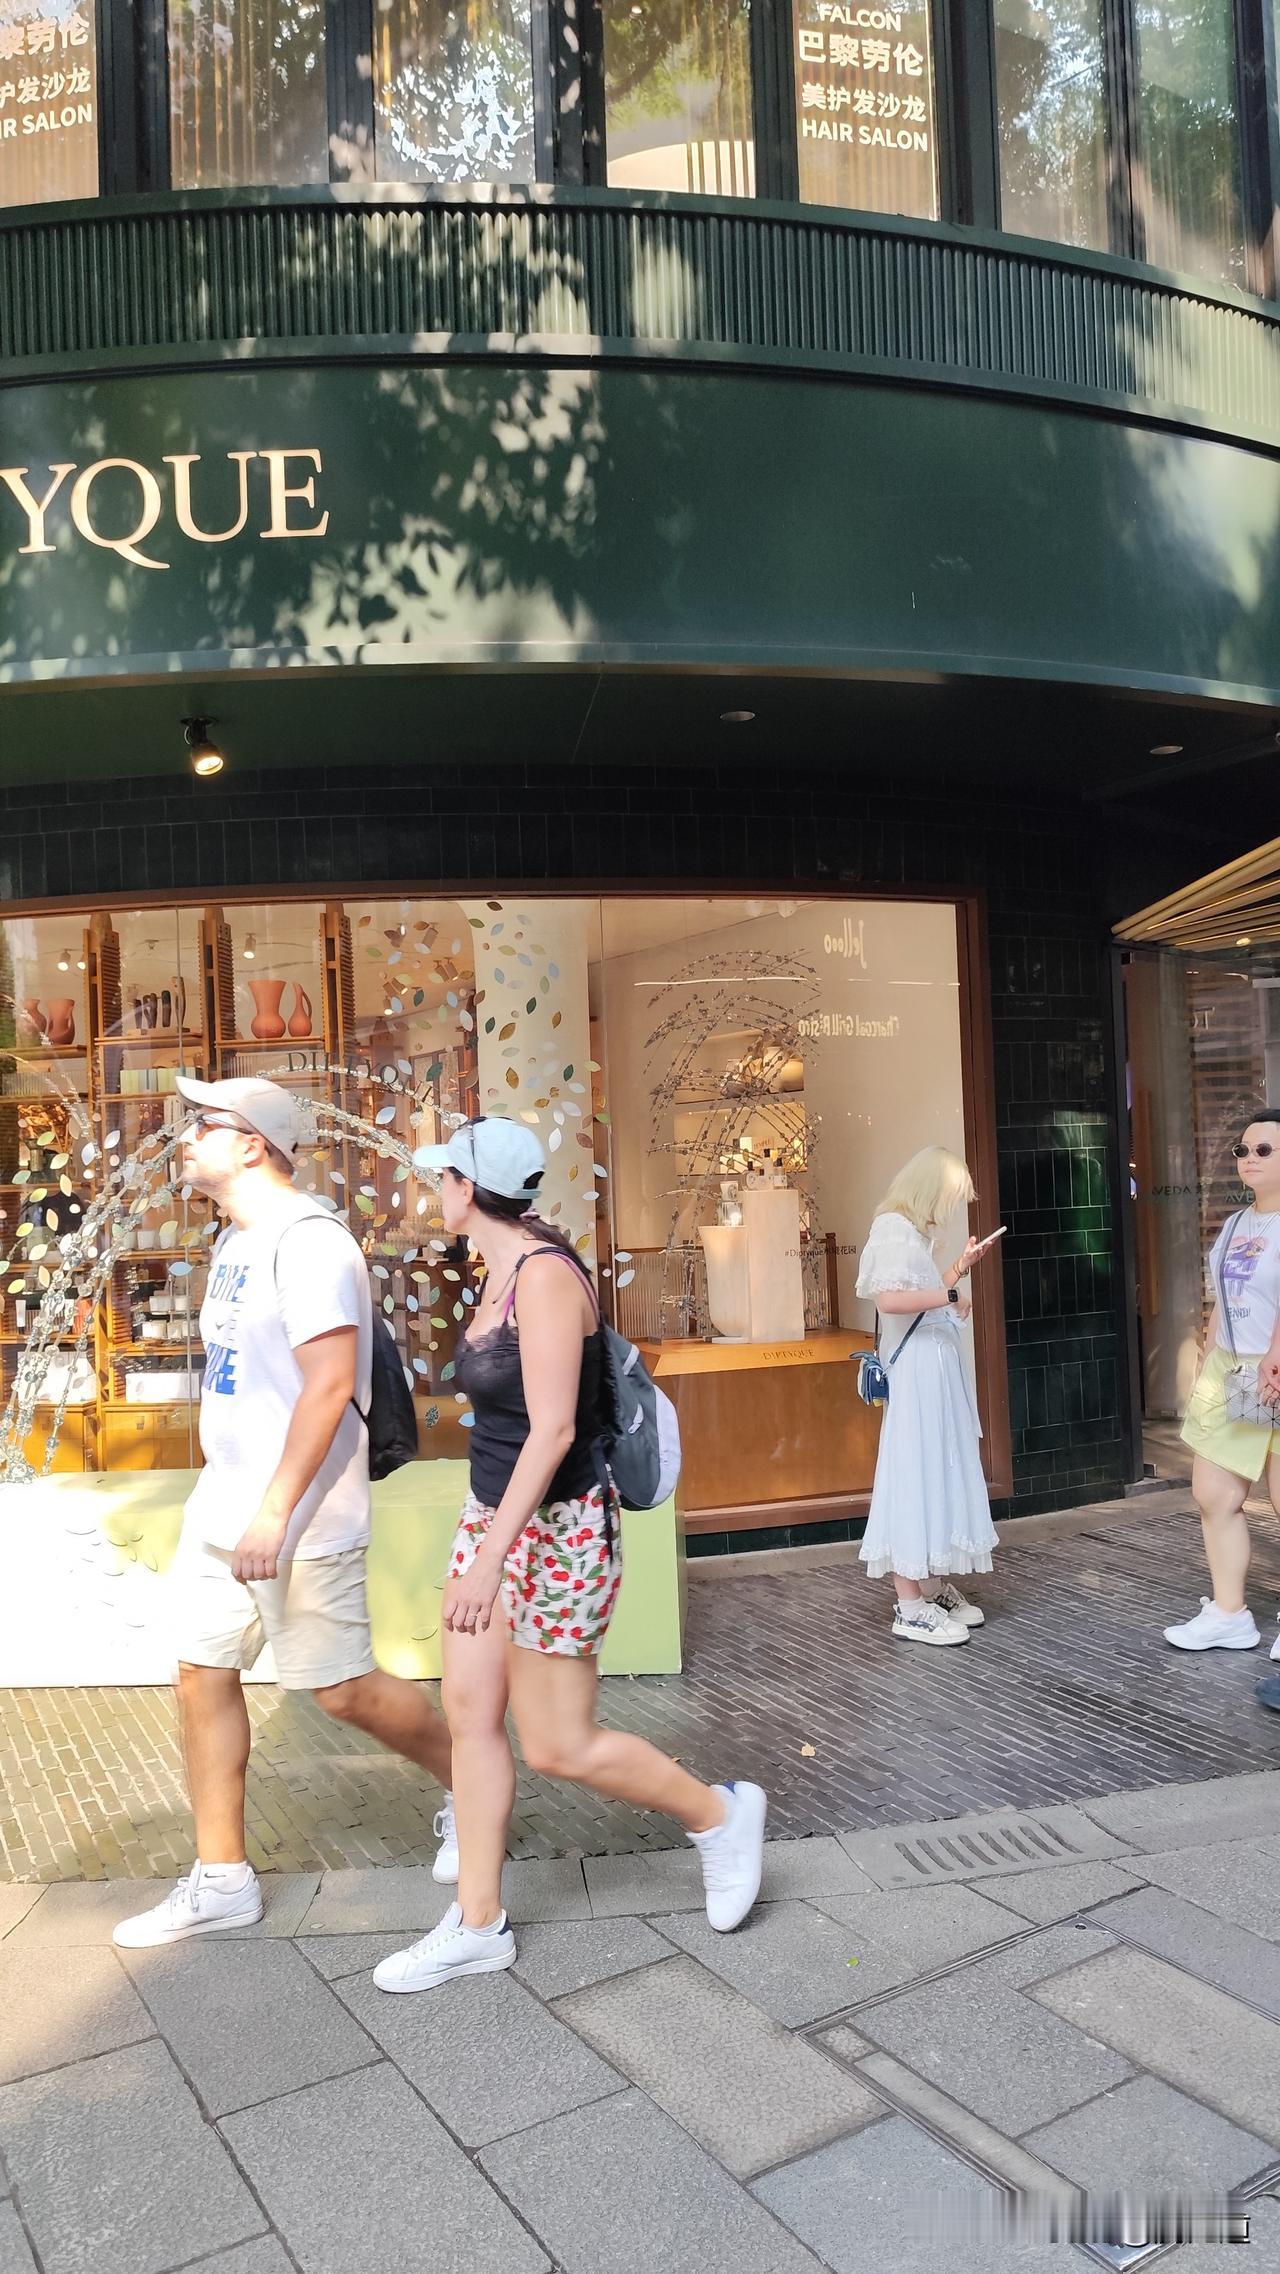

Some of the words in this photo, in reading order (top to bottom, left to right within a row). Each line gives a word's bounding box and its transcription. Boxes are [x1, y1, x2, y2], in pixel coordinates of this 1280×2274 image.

[819, 3, 902, 32] FALCON
[798, 29, 924, 76] 巴黎劳伦
[22, 103, 93, 135] SALON
[802, 82, 927, 122] 美护发沙龙
[802, 118, 854, 143] HAIR
[858, 125, 928, 152] SALON
[0, 449, 330, 570] YQUE
